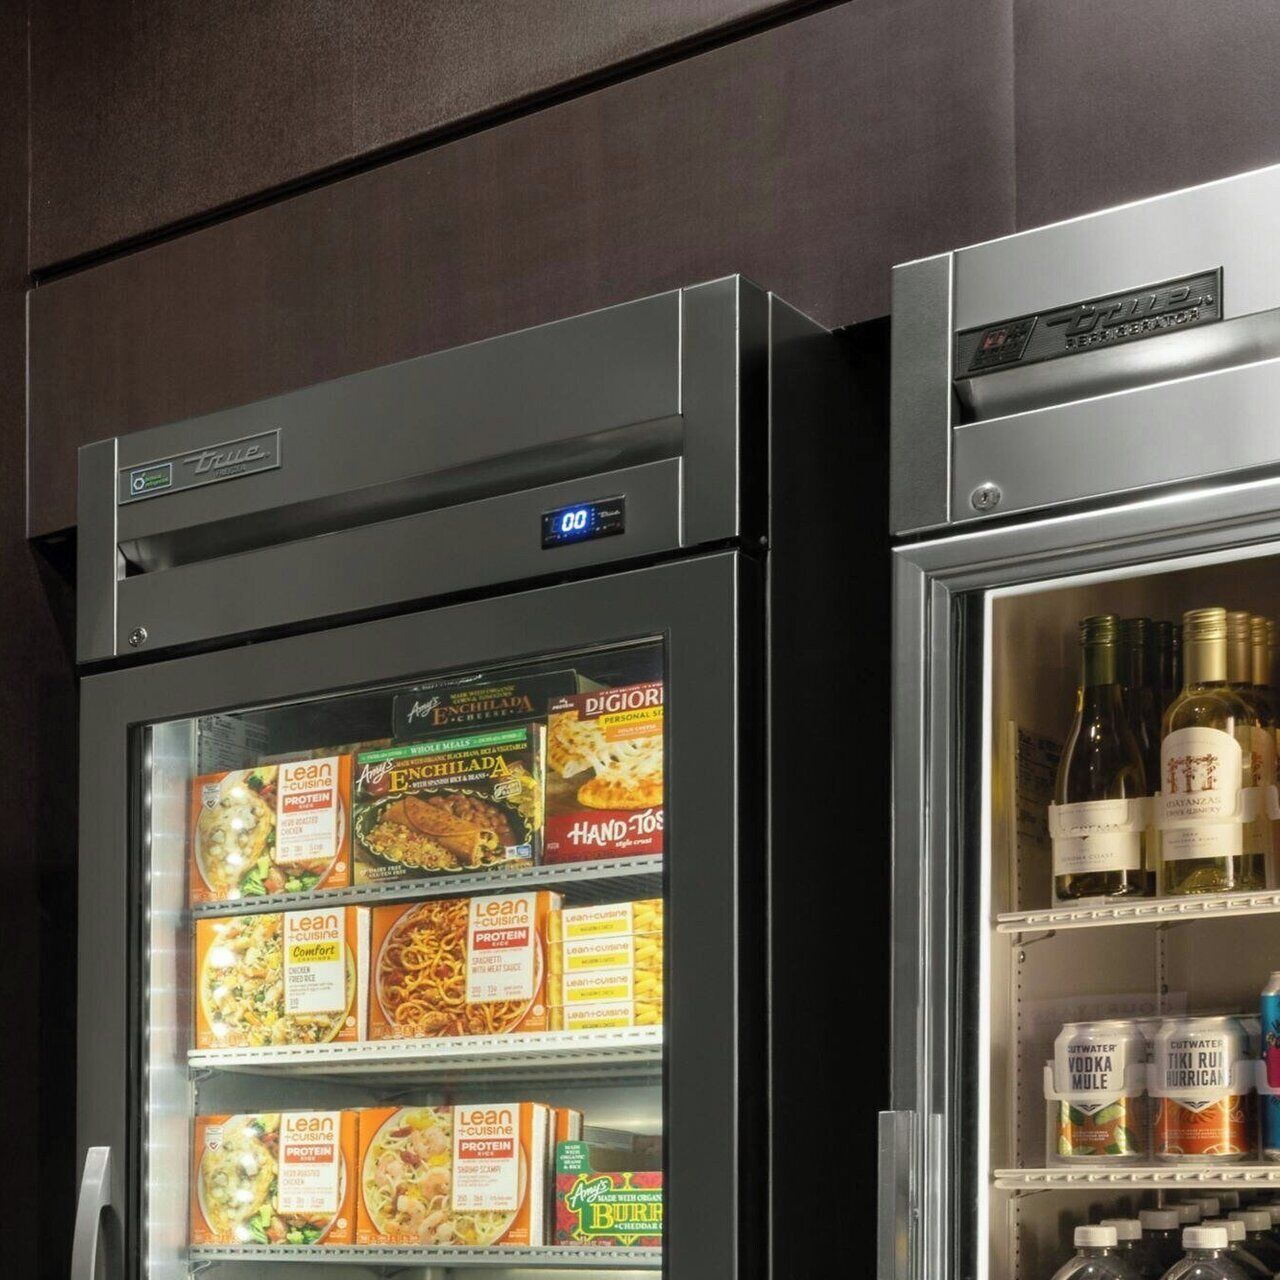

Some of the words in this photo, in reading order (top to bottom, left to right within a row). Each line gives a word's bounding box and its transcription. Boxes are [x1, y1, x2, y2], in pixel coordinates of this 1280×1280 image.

[1065, 308, 1201, 350] REFRIGERATOR
[561, 510, 587, 532] 00
[432, 695, 534, 726] ENCHILADA
[604, 712, 650, 724] PERSONAL
[410, 743, 441, 755] WHOLE
[442, 740, 471, 751] MEALS
[356, 758, 395, 792] Amy's
[389, 756, 513, 792] ENCHILADA
[284, 793, 331, 806] PROTEIN
[616, 839, 633, 849] style
[634, 837, 652, 846] crust
[476, 898, 529, 917] Lean
[290, 914, 338, 932] Lean
[476, 930, 527, 943] PROTEIN
[292, 945, 335, 959] Comfort
[1068, 1057, 1112, 1073] VODKA
[1168, 1053, 1194, 1069] TIKI
[1072, 1074, 1108, 1090] MULE
[286, 1117, 333, 1132] Lean
[461, 1141, 511, 1151] PROTEIN
[569, 1179, 609, 1208] Amy's
